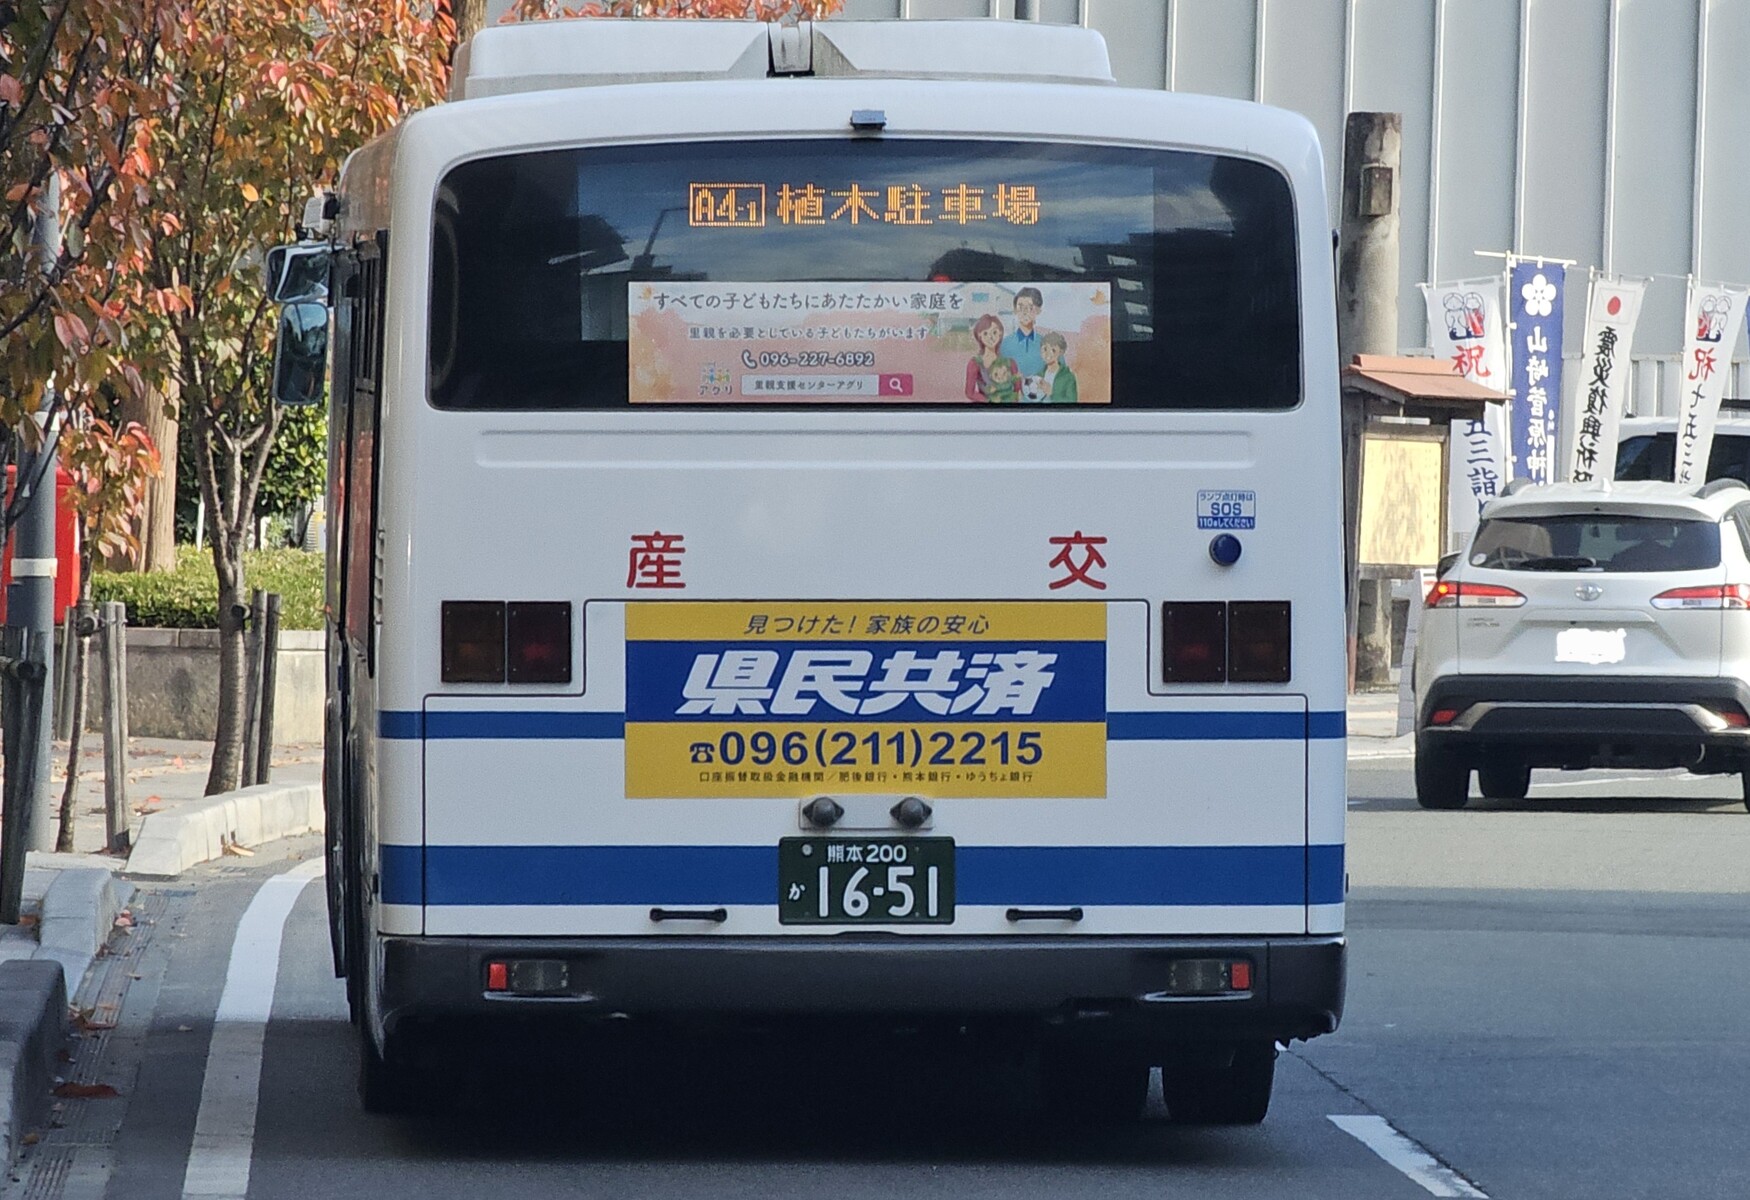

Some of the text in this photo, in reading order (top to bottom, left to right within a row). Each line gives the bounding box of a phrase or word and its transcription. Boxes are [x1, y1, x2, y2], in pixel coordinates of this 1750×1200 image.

[777, 183, 1041, 225] 植木駐車場
[653, 292, 964, 311] すべての子どもたちにあたたかい家庭を
[689, 326, 929, 340] 里親を必要としている子どもたちがいます
[759, 351, 875, 368] 096-227-6892
[754, 380, 864, 392] 里親支援センターアグリ
[1210, 502, 1242, 516] SOS
[626, 531, 1107, 590] 産 交
[675, 649, 1058, 716] 県民共済
[718, 728, 1044, 768] 096(211)2215
[788, 882, 806, 900] か
